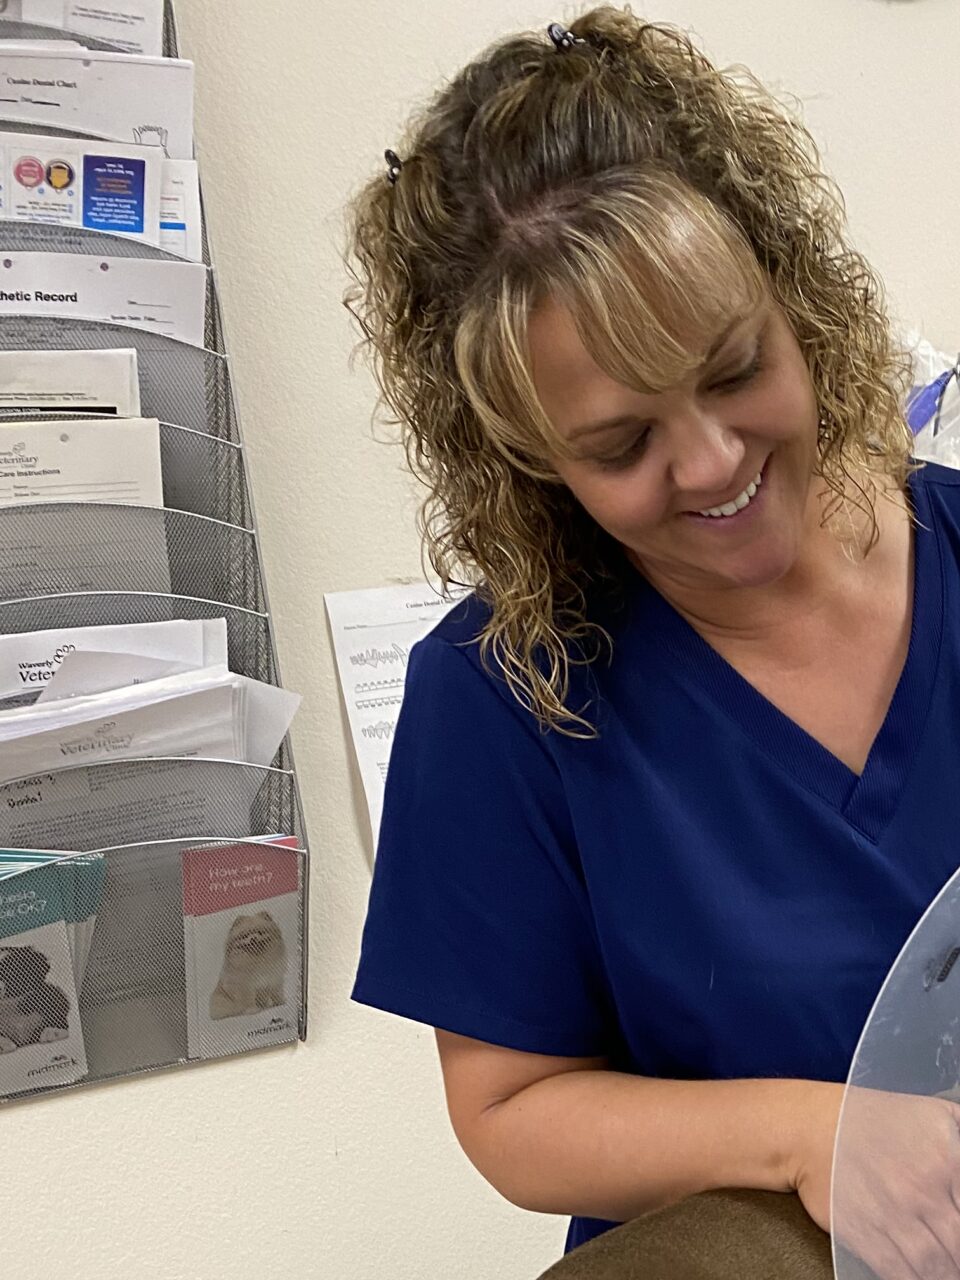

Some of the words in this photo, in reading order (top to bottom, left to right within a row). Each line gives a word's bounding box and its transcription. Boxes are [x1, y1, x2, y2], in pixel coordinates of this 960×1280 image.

[35, 292, 78, 302] Record
[19, 660, 54, 669] Waverly
[27, 1058, 77, 1077] midmark
